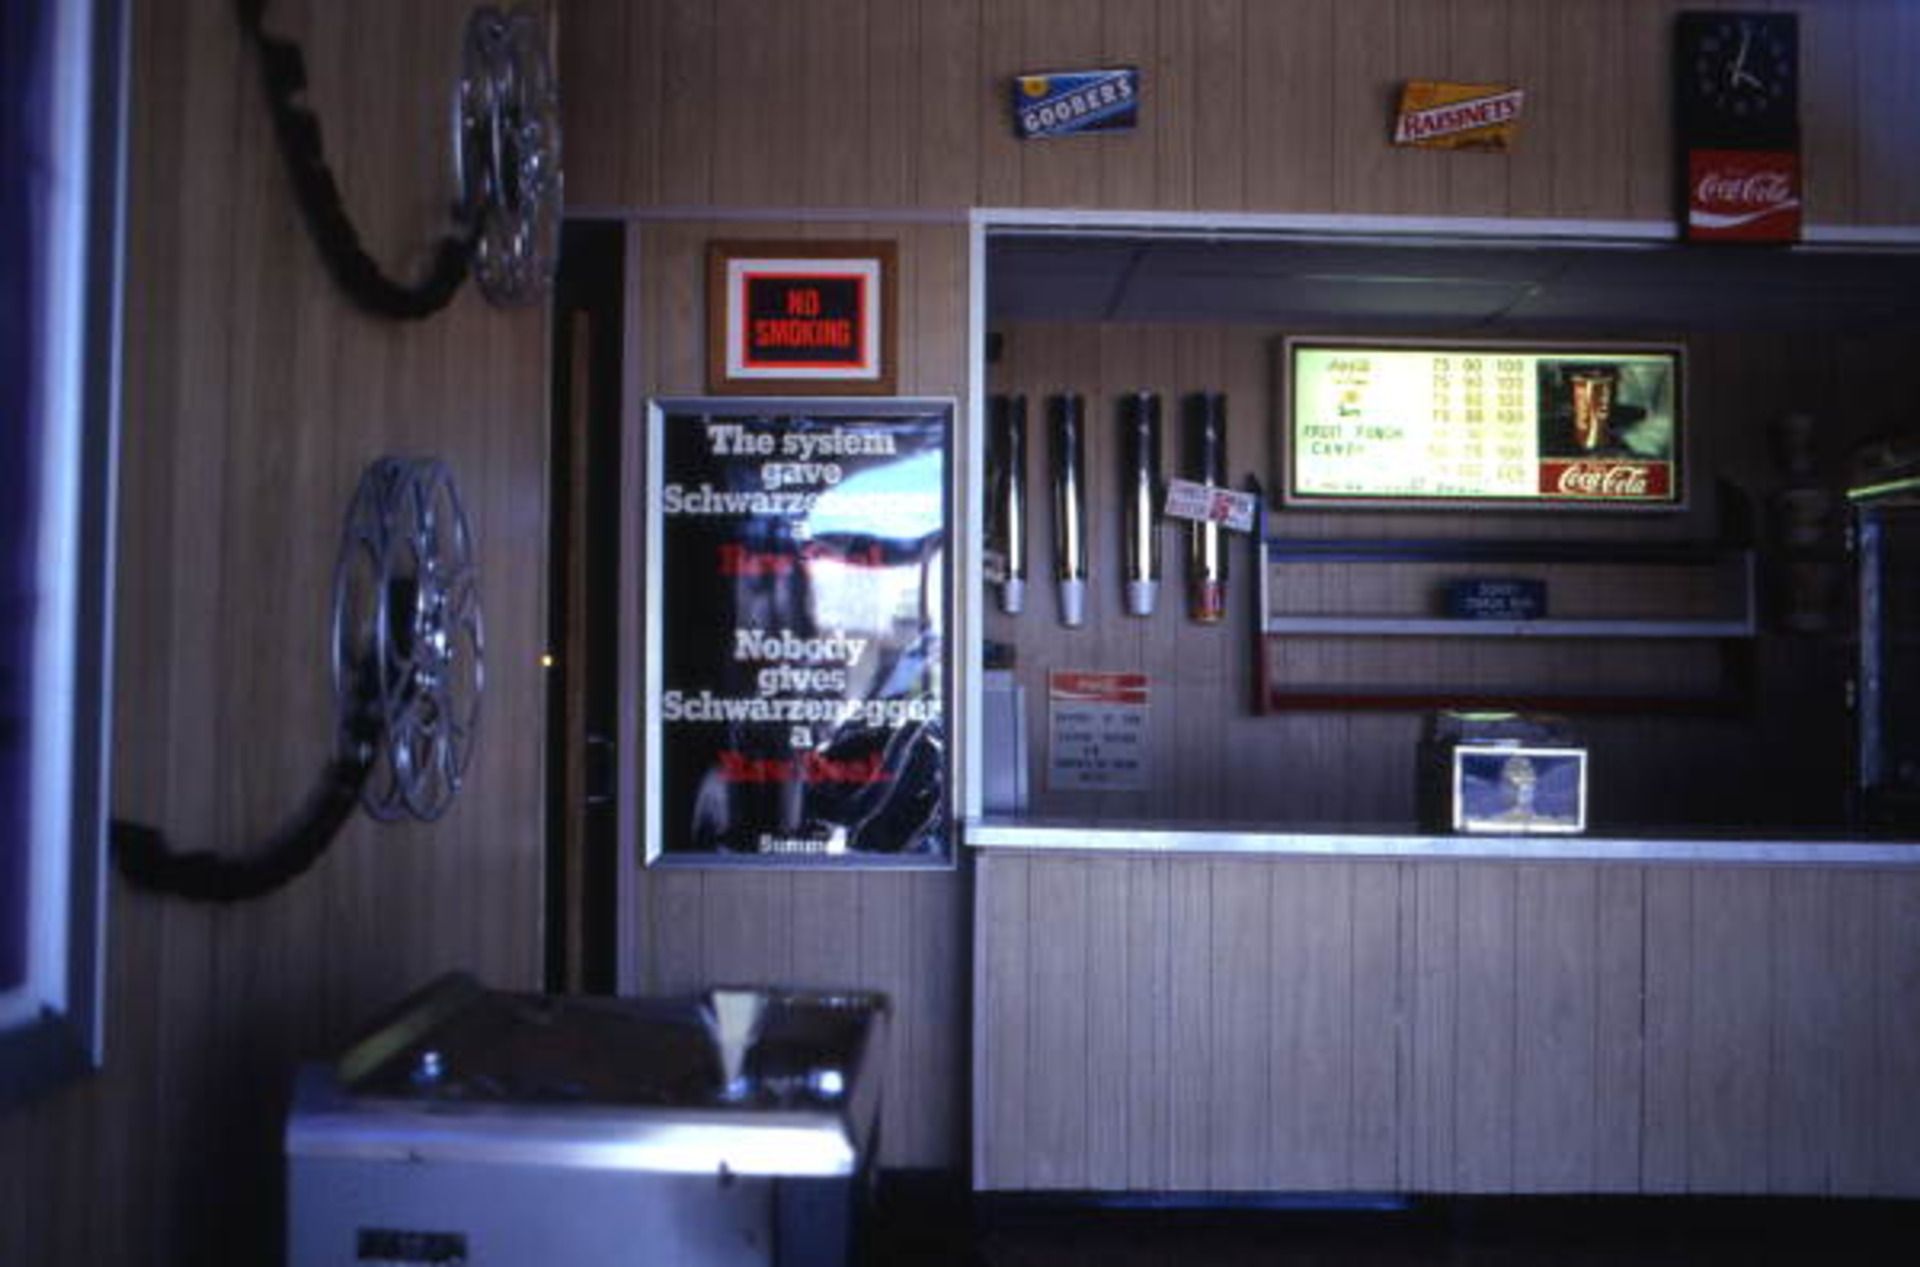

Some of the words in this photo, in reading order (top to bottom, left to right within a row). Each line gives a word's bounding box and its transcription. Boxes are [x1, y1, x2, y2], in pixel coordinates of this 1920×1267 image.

[1024, 77, 1132, 131] GOOBERS
[1404, 99, 1514, 137] RAISINETS
[787, 288, 820, 316] NO
[754, 319, 851, 347] SMOKING
[706, 424, 775, 455] The
[782, 427, 897, 460] system
[760, 462, 842, 489] gave
[1557, 464, 1648, 495] Coca-Cola
[734, 629, 868, 666] Nobody
[757, 664, 847, 695] gives
[662, 690, 942, 727] Schwarzenegger
[790, 726, 812, 747] a
